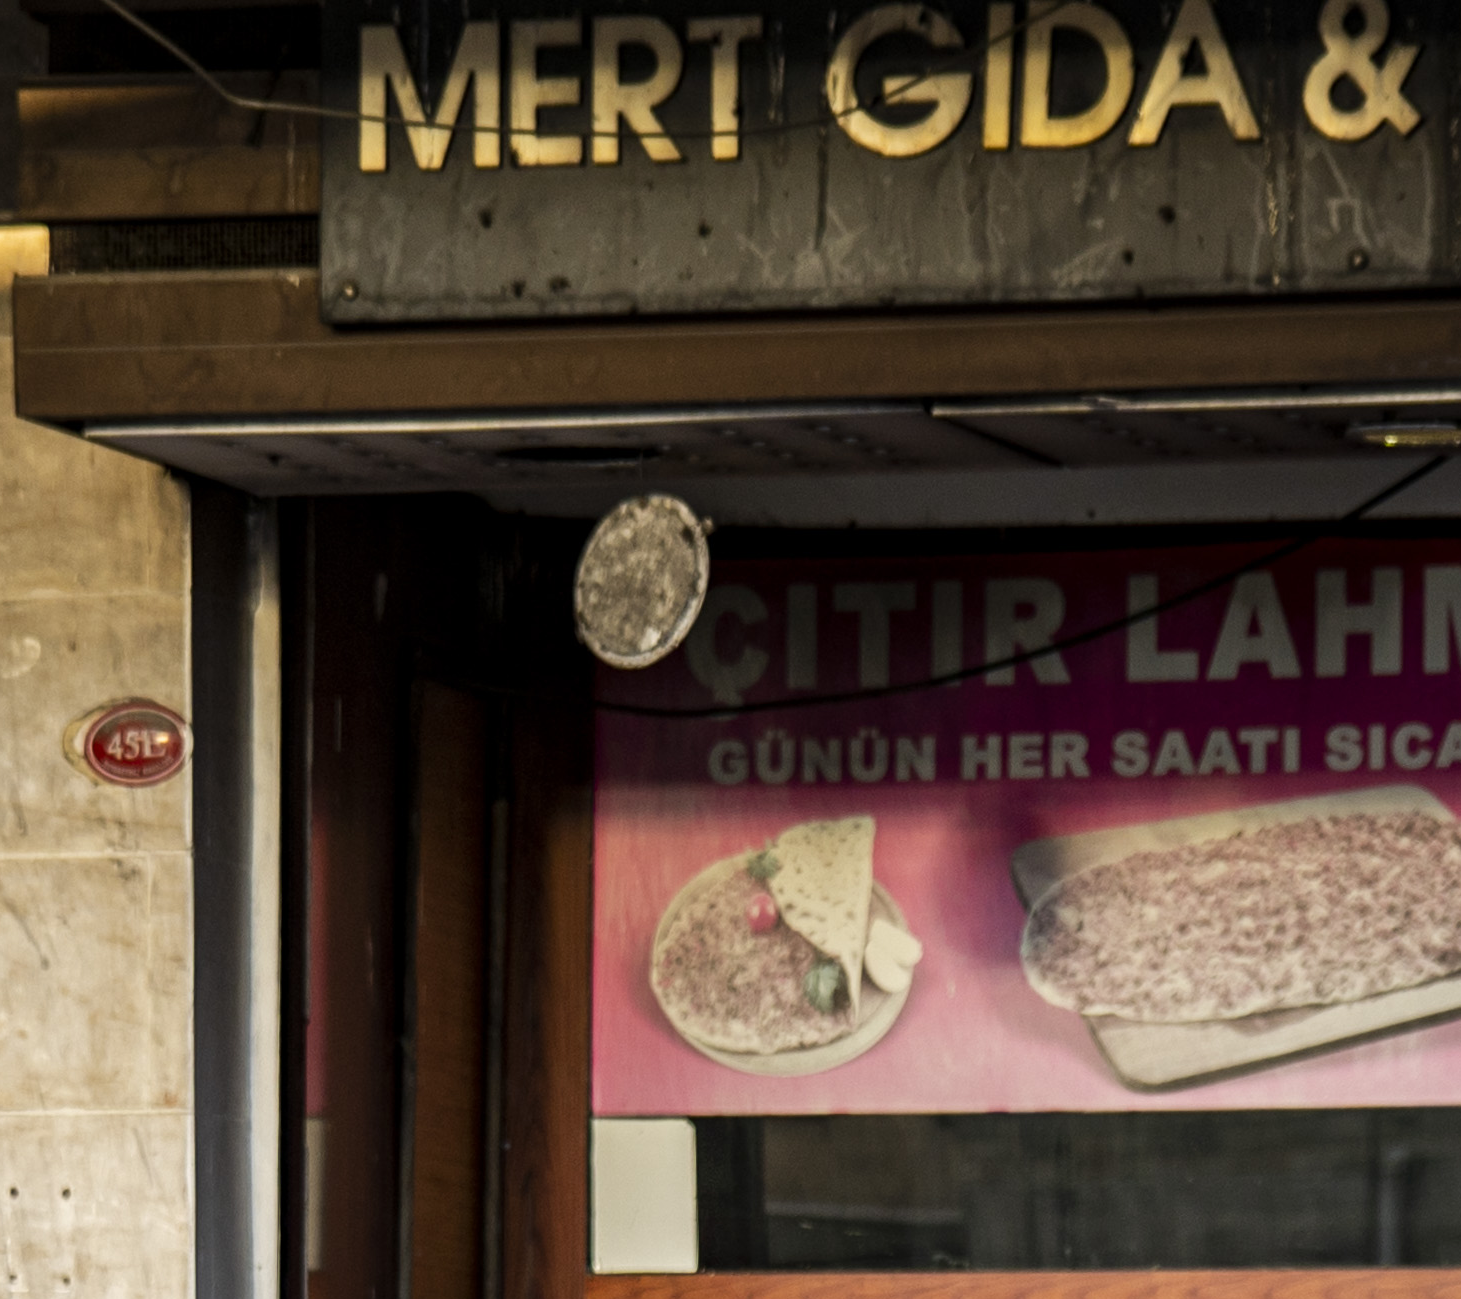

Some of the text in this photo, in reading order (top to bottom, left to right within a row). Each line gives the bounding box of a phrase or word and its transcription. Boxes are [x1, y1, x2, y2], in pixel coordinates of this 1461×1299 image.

[358, 14, 765, 171] MERT
[825, 1, 1261, 157] GIDA
[1302, 0, 1427, 140] &
[683, 576, 1072, 721] ÇITIR
[708, 727, 937, 784] GÜNÜN
[960, 729, 1090, 780] HER
[1110, 724, 1302, 778] SAATI
